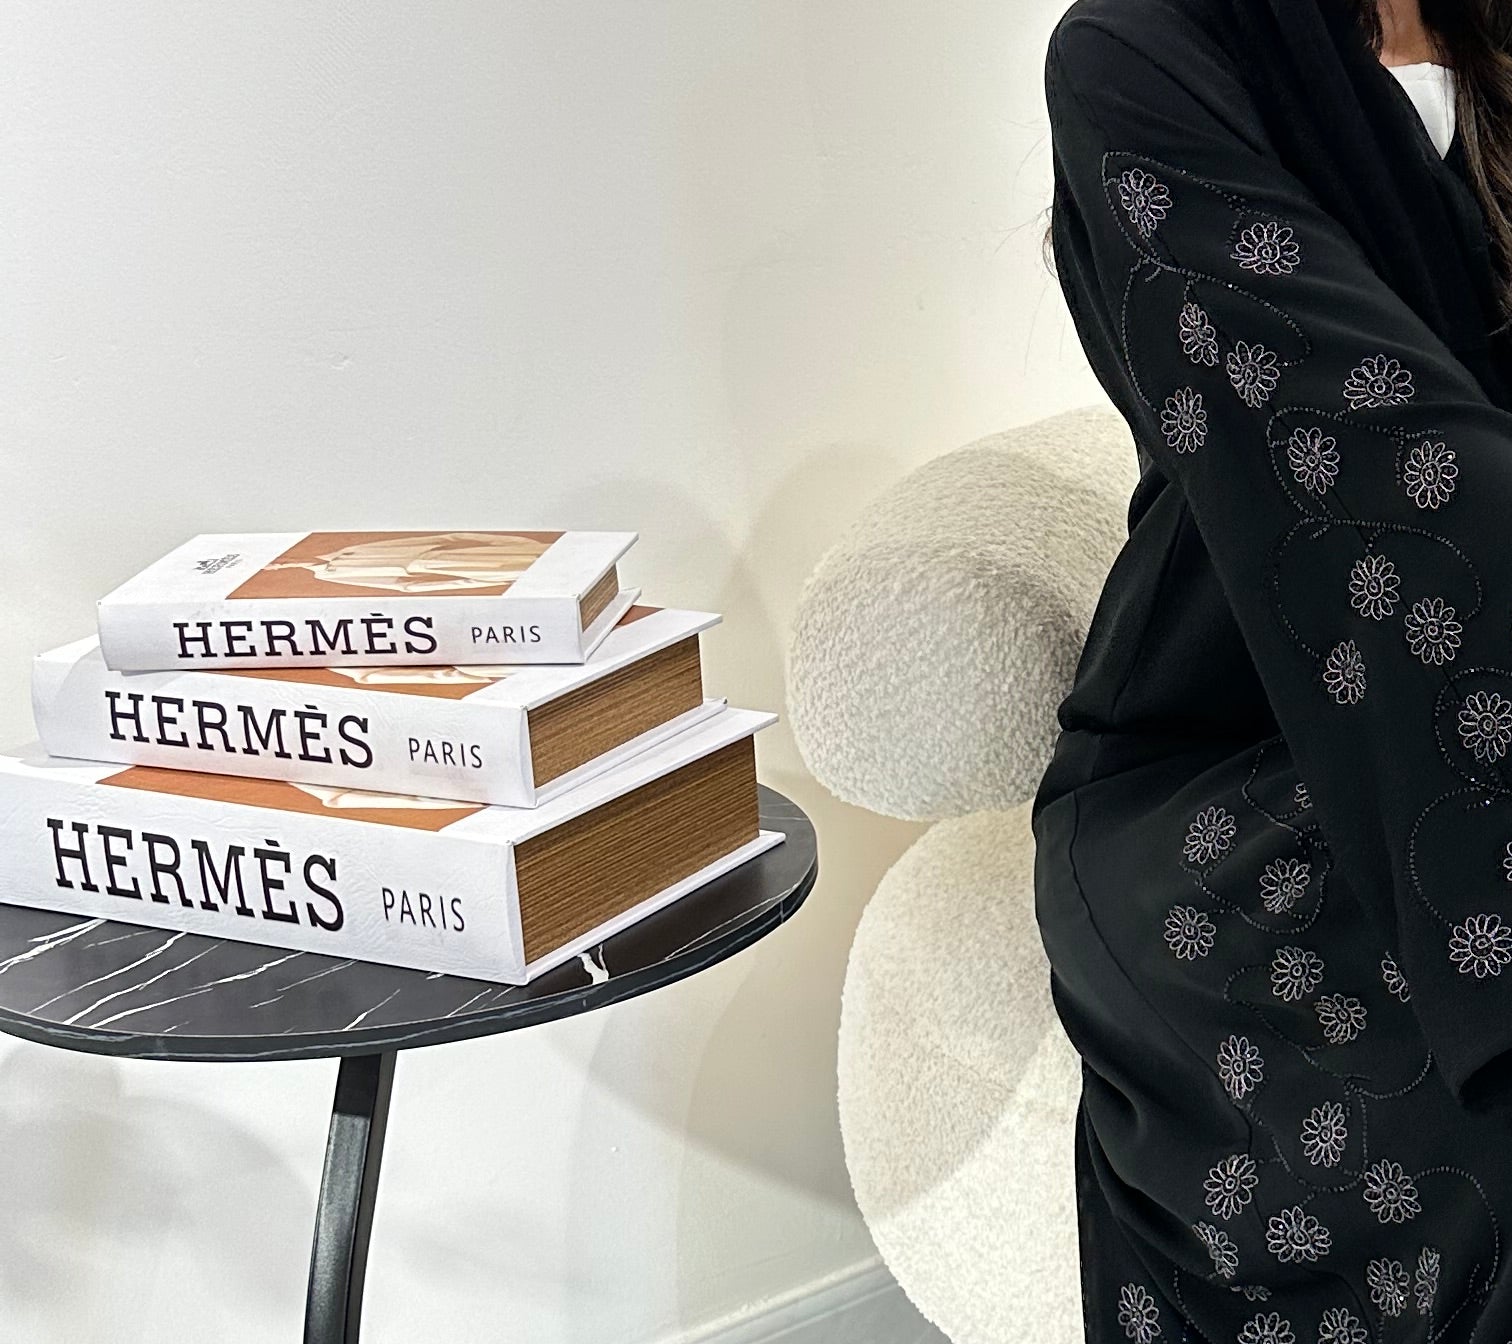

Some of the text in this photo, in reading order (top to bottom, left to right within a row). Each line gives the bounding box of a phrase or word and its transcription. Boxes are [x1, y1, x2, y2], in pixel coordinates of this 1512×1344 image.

[173, 613, 541, 658] HERMÈS PARIS
[105, 691, 483, 769] HERMÈS PARIS
[46, 818, 465, 932] HERMÈS PARIS
